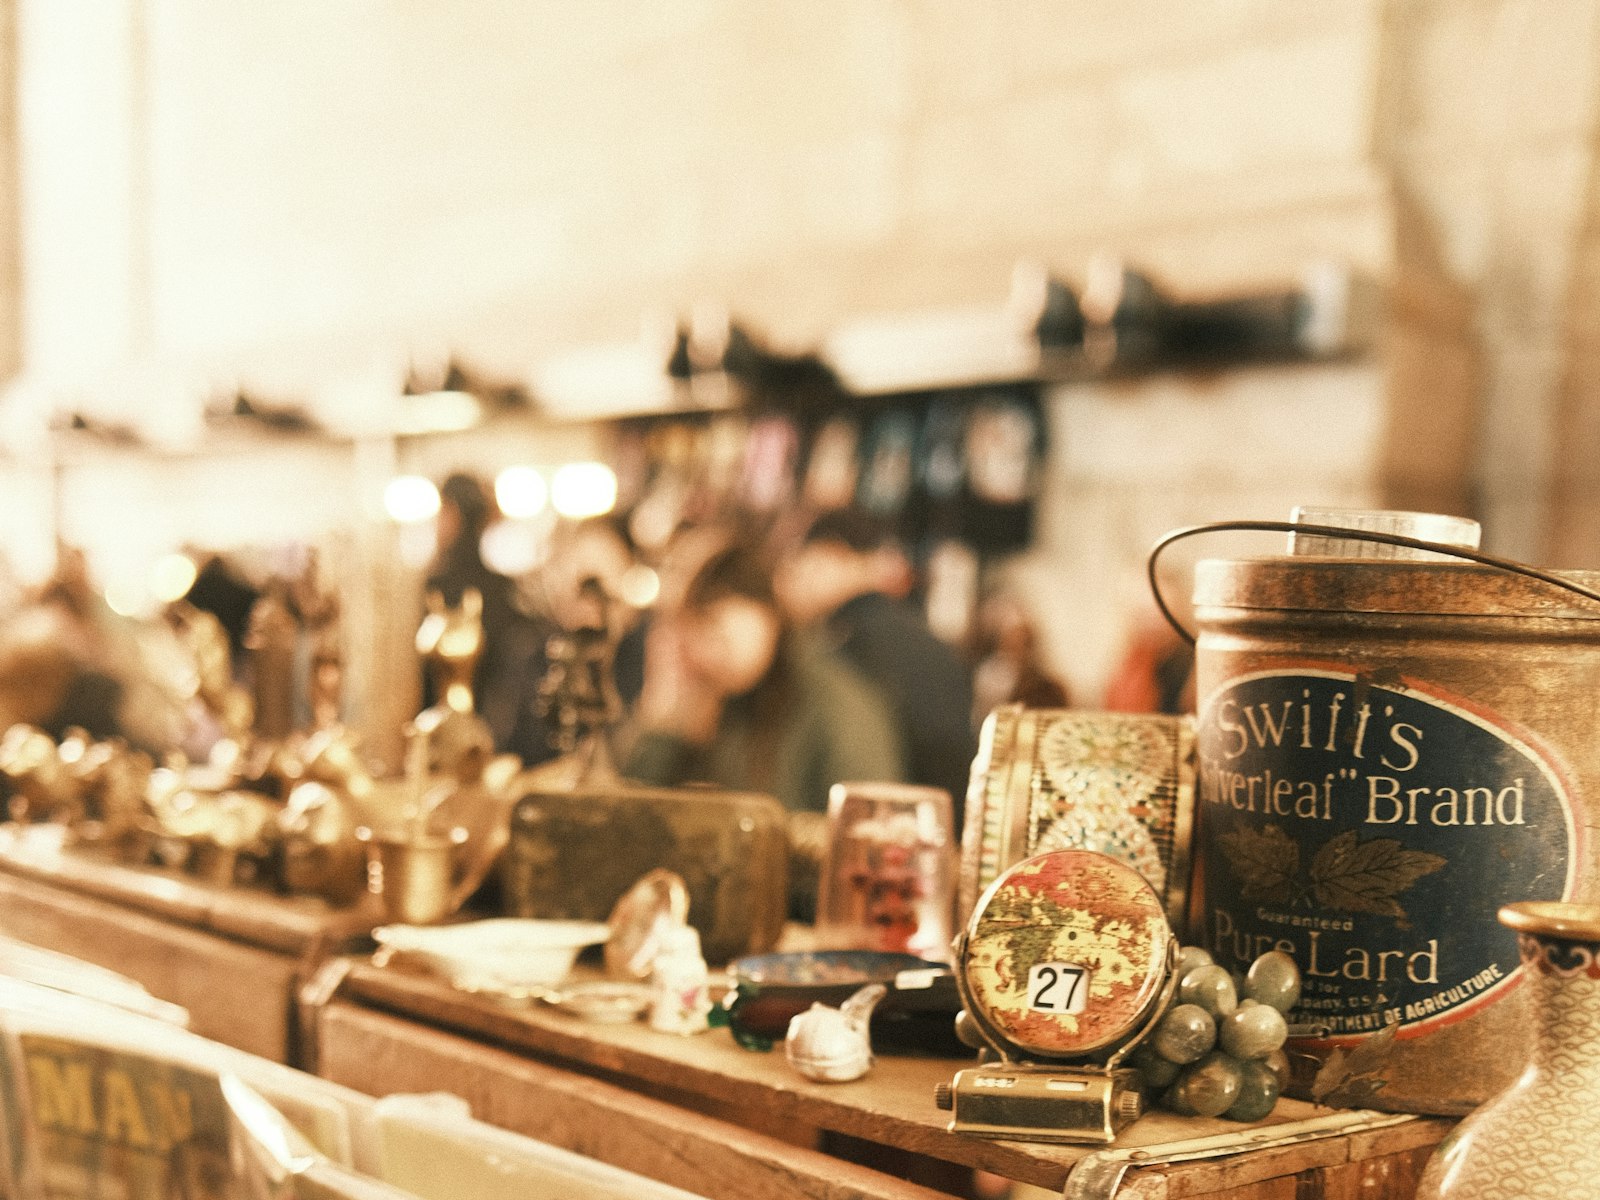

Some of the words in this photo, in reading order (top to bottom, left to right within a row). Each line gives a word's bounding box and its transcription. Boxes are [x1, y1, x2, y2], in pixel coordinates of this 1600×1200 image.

[1217, 687, 1424, 772] Swift's
[1364, 777, 1527, 827] Brand
[1306, 930, 1440, 985] Lard
[1033, 966, 1085, 1011] 27
[1405, 963, 1504, 1021] AGRICULTURE
